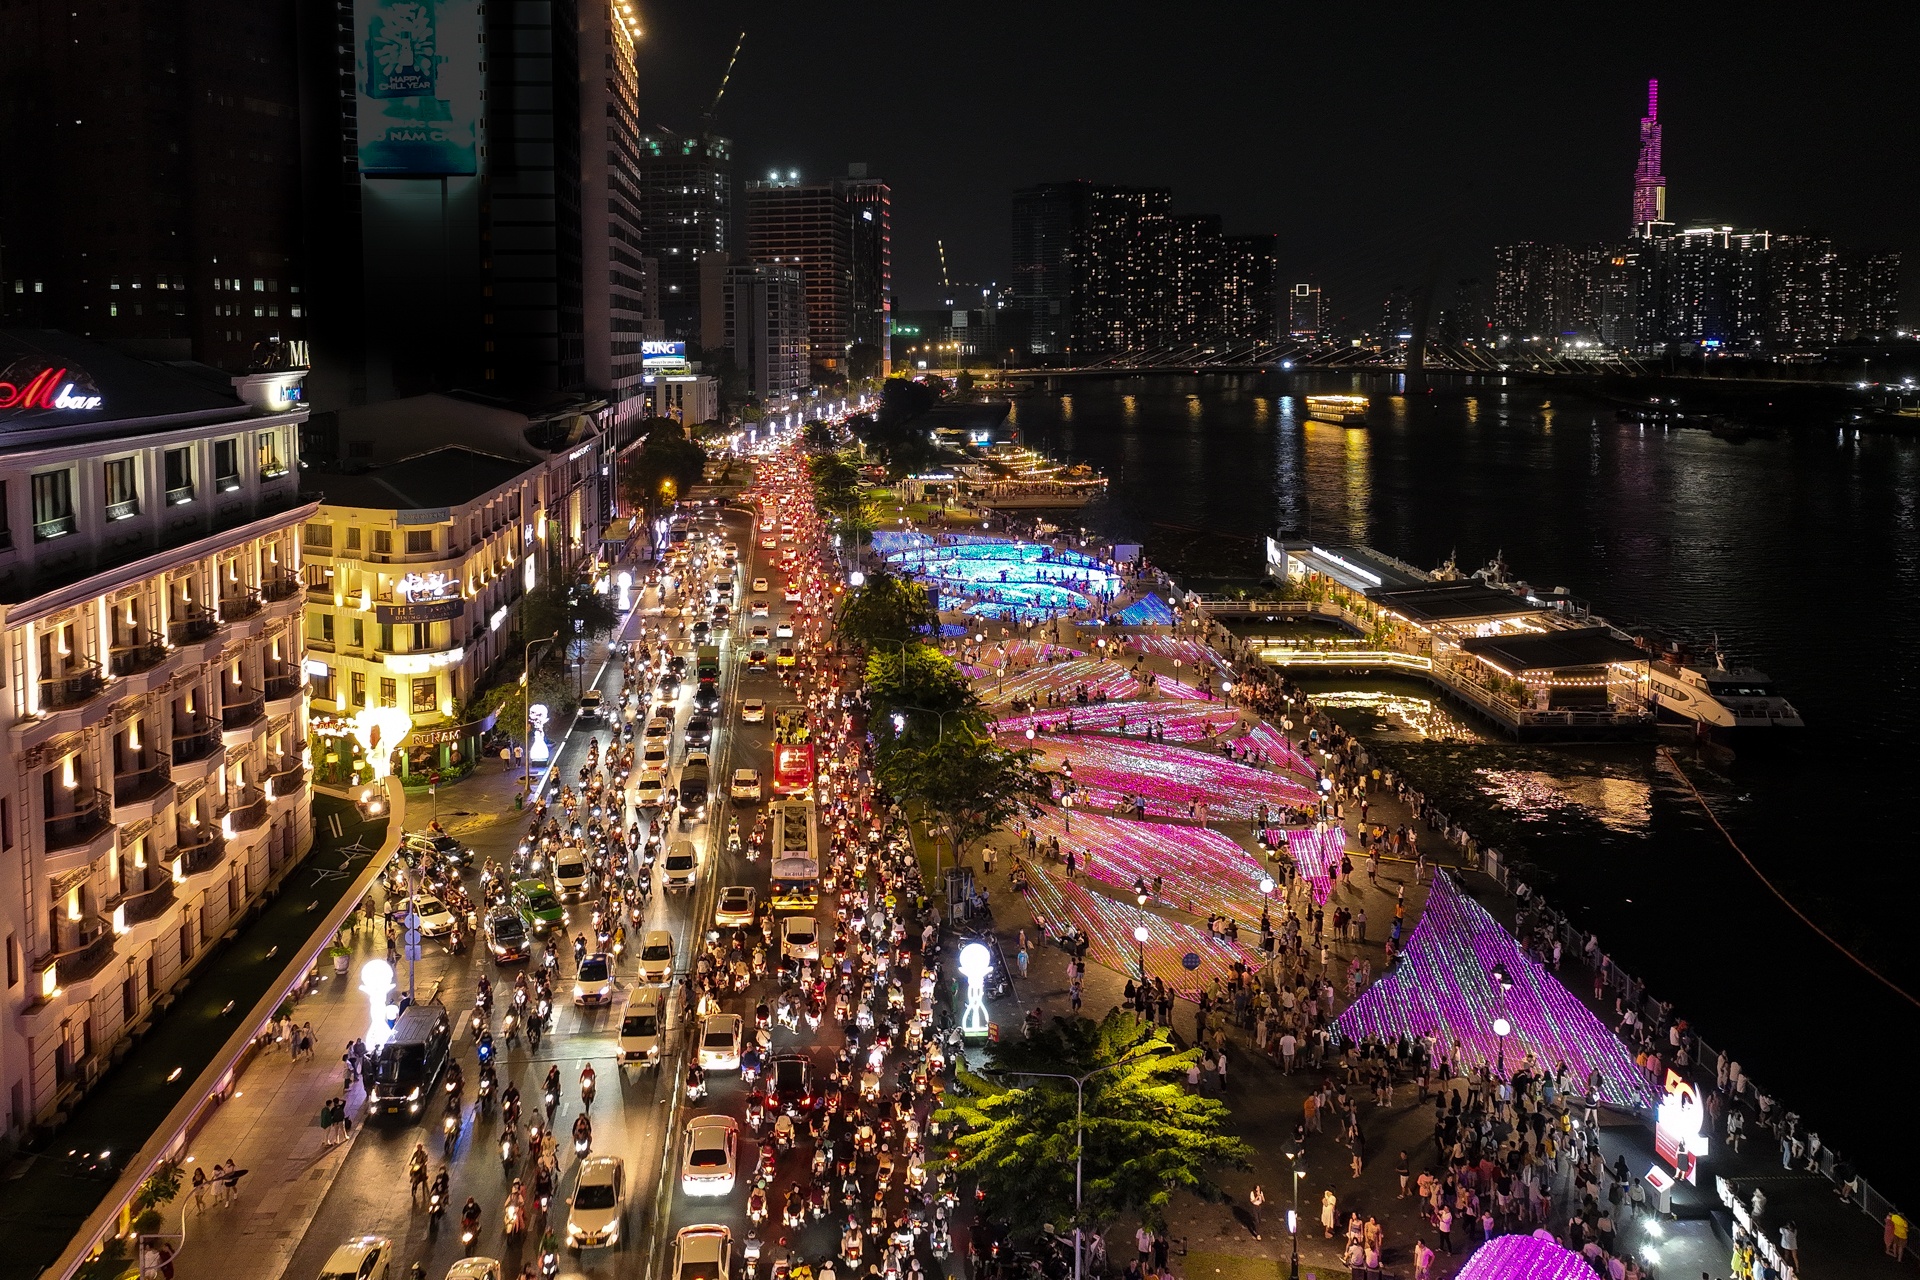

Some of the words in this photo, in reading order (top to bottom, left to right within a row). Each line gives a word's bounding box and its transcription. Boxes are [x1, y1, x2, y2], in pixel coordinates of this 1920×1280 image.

[390, 75, 421, 83] HAPPY
[378, 83, 406, 91] CHILL
[407, 81, 431, 89] YEAR
[641, 343, 676, 354] SUNG
[388, 606, 416, 616] THE
